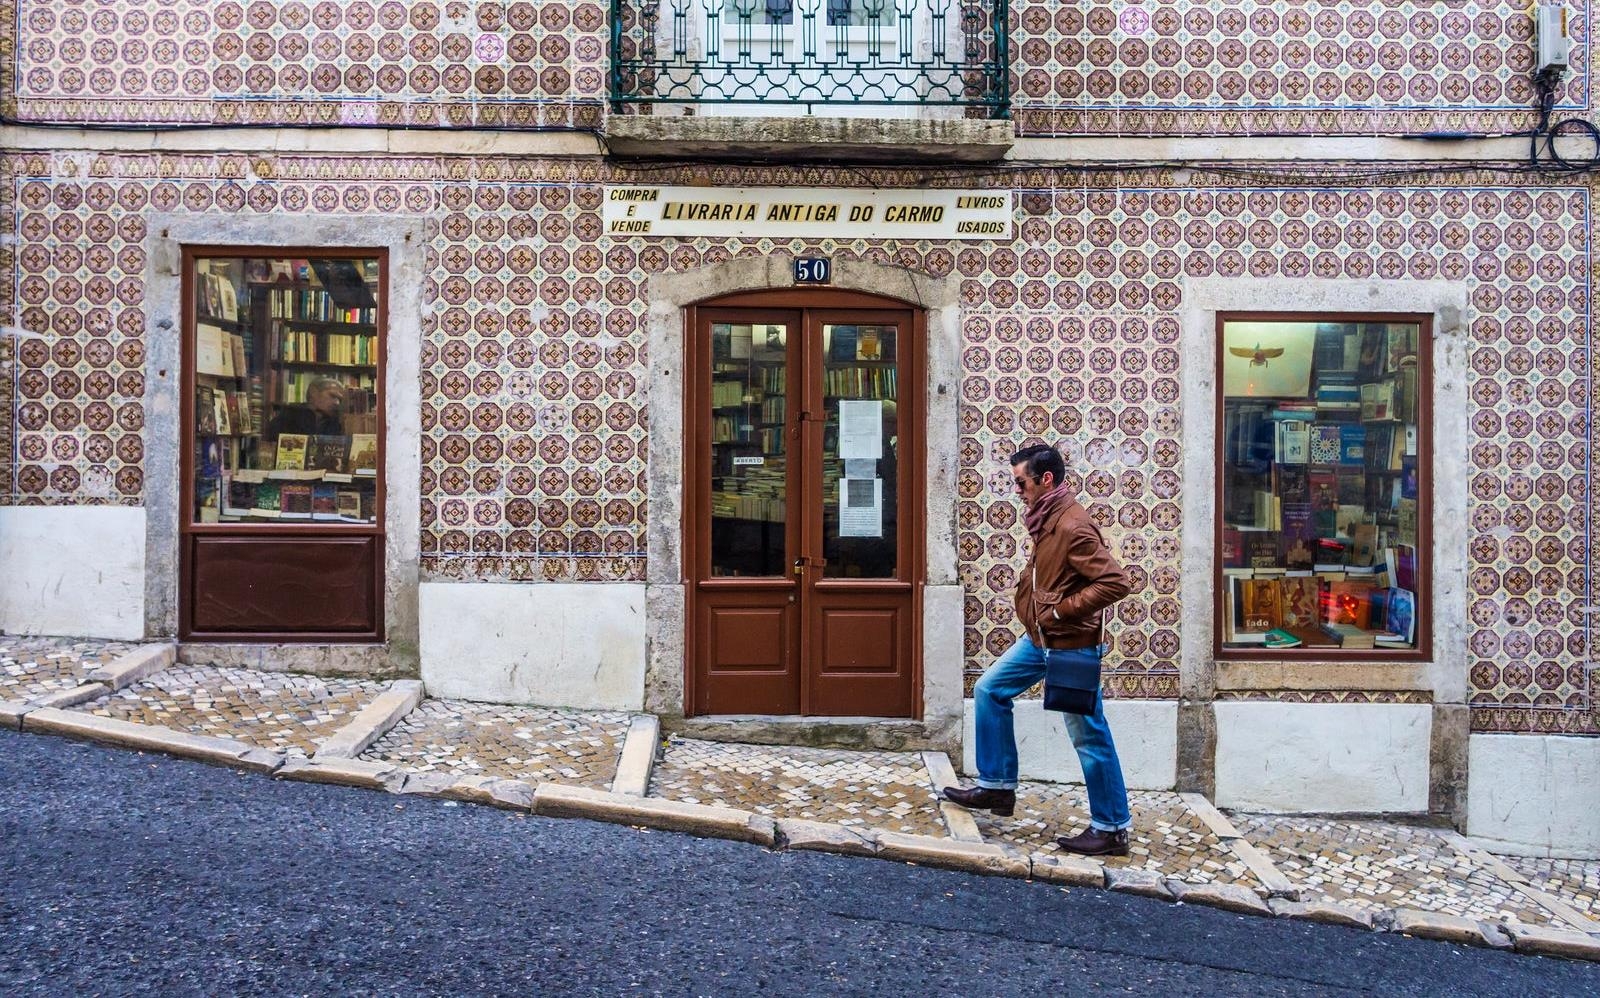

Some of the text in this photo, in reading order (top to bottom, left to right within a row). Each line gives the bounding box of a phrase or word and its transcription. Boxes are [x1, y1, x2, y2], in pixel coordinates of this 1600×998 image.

[610, 189, 657, 201] COMPRA
[957, 196, 1005, 208] LIVROS
[627, 205, 635, 216] E
[662, 203, 944, 222] LIVRARIA ANTIGA DO CARMO
[611, 220, 651, 232] VENDE
[957, 221, 1005, 233] USADOS
[798, 260, 825, 281] 50
[1246, 619, 1269, 627] fado
